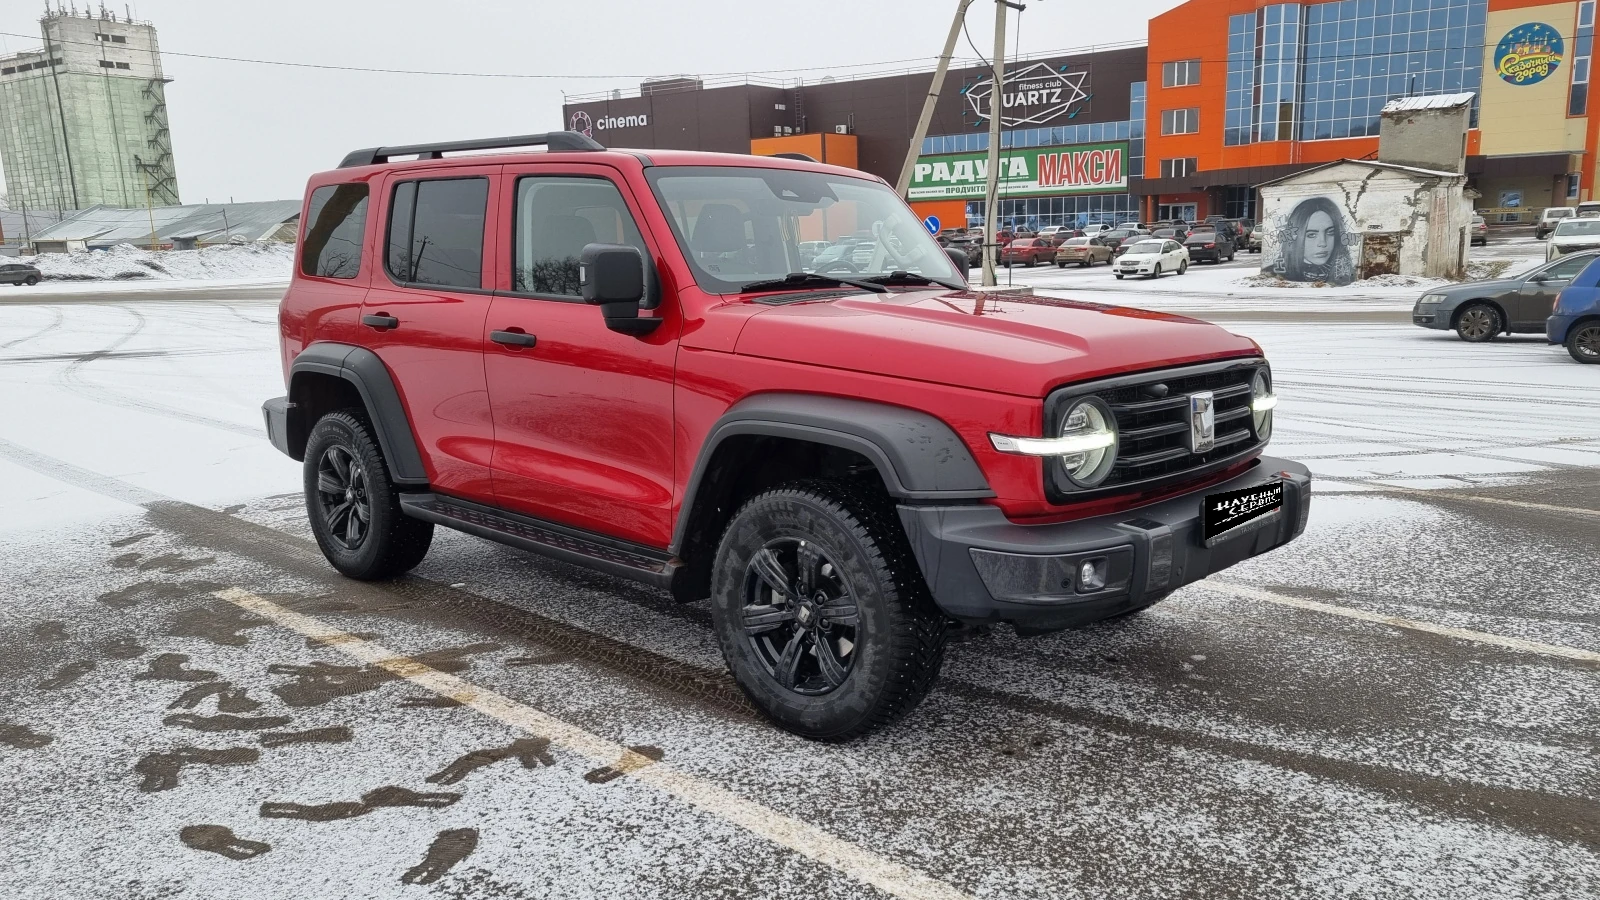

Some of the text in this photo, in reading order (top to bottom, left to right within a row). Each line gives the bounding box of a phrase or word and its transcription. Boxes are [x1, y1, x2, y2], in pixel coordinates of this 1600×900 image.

[1018, 80, 1062, 91] fitness club
[989, 88, 1062, 108] UARTZ
[596, 114, 648, 130] cinema
[1037, 149, 1121, 187] МАКСИ
[945, 185, 986, 194] ПРОДУКТО
